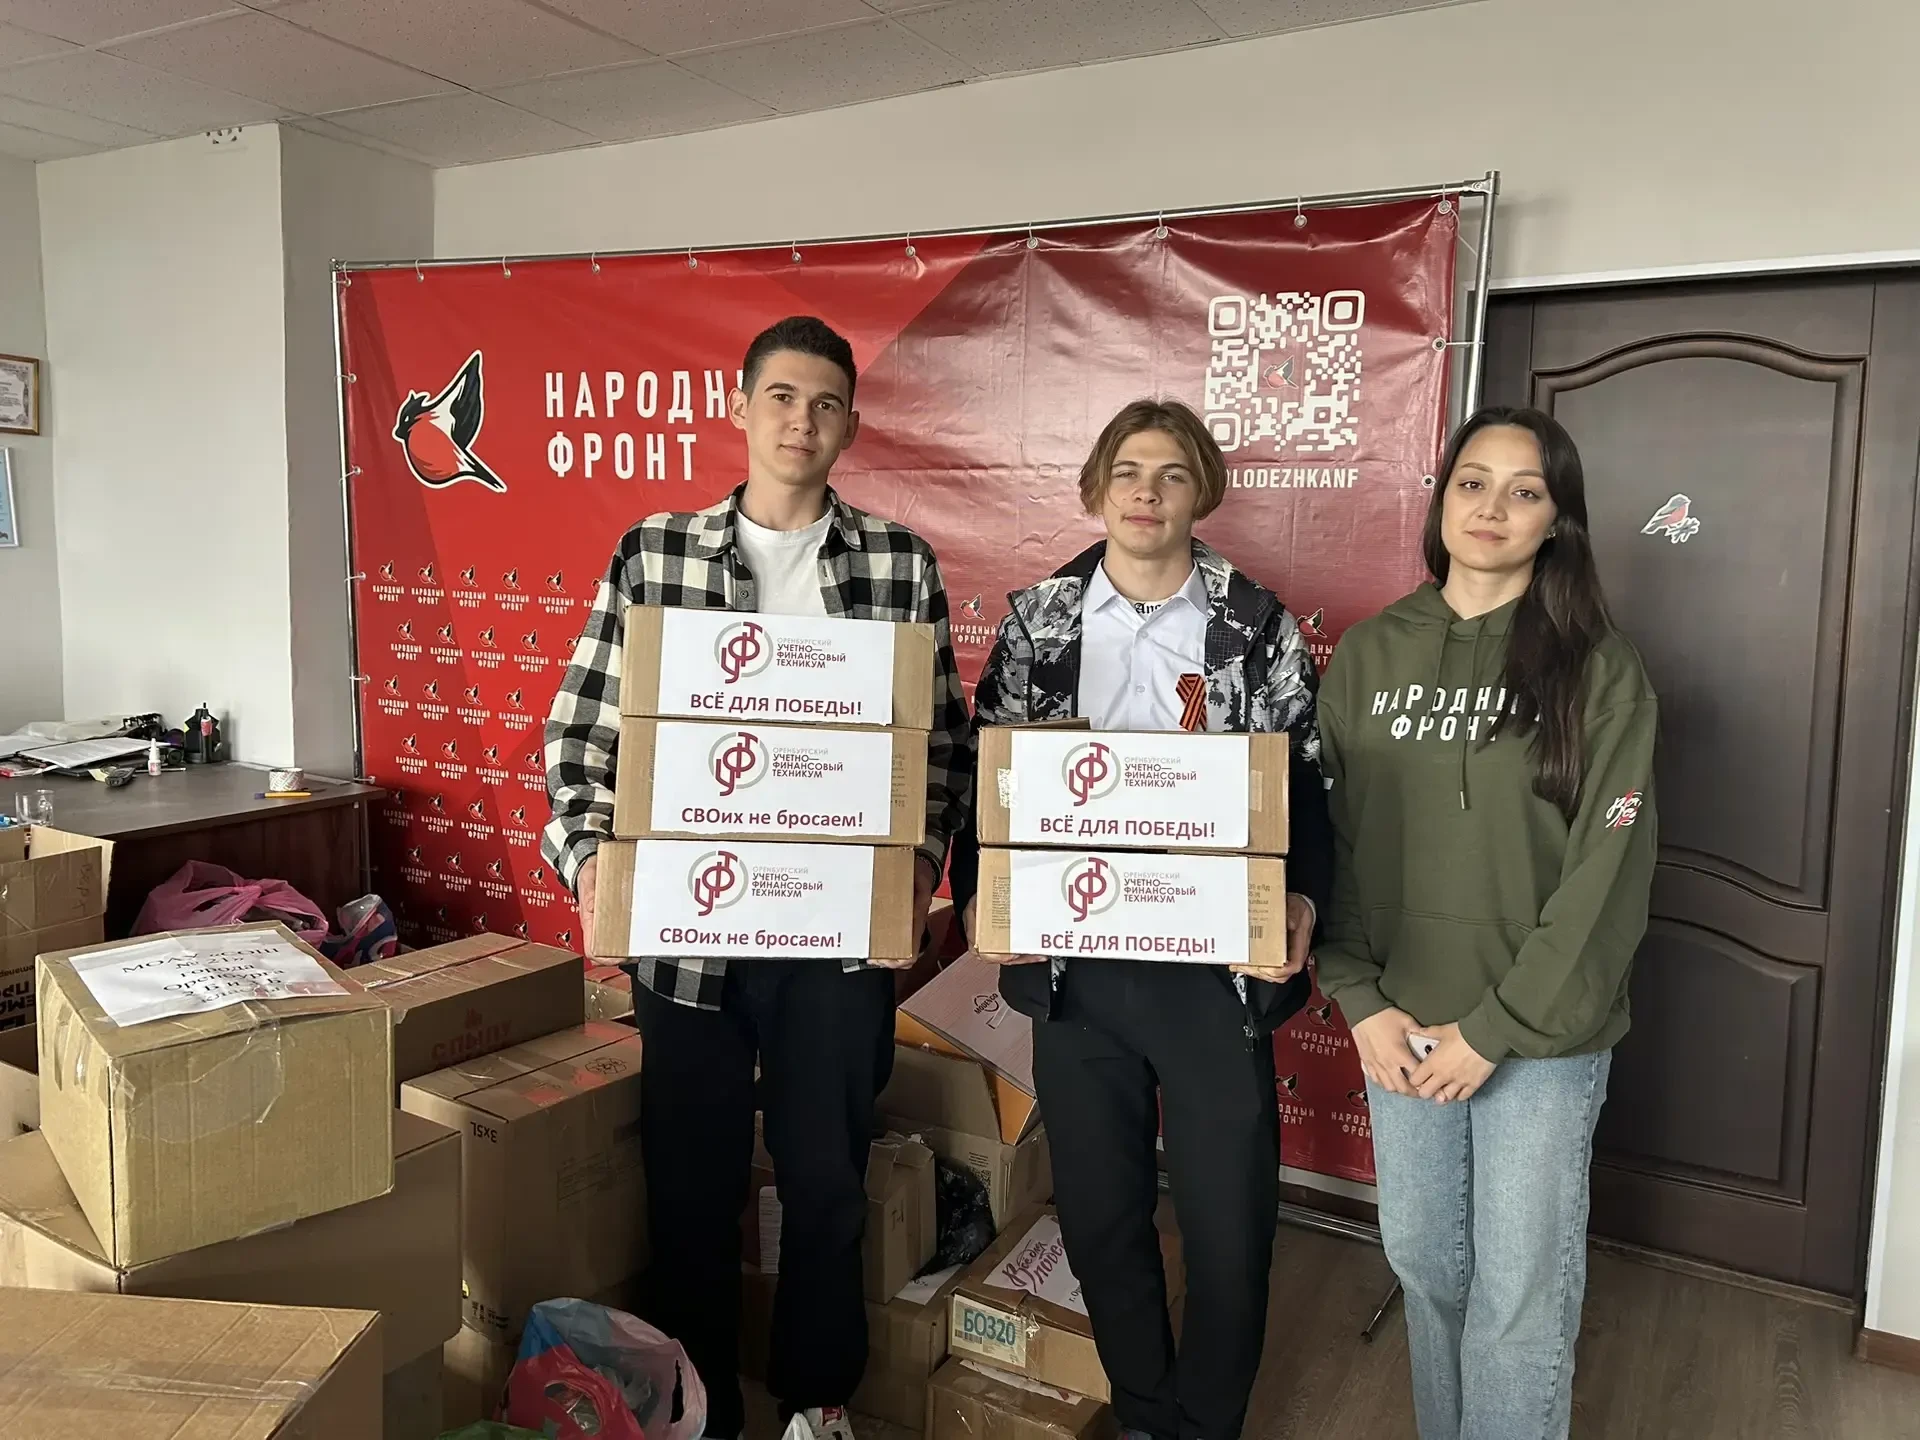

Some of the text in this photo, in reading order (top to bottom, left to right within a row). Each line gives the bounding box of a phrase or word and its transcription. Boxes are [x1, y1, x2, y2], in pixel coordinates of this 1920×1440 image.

[545, 369, 744, 424] НАРОДН
[548, 431, 696, 481] ФРОНТ
[1227, 468, 1358, 488] LODEZHKANF
[958, 635, 986, 644] ФРОНТ
[776, 652, 846, 662] ФИНАНСОВЫЙ
[776, 658, 826, 668] ТЕХНИКУМ
[690, 692, 862, 716] ВСЁ ДЛЯ ПОБЕДЫ!
[772, 761, 843, 772] ФИНАНСОВЫЙ
[517, 773, 546, 784] НАРОДН
[772, 769, 823, 778] ТЕХНИКУМ
[1124, 771, 1196, 780] ФИНАНСОВЫЙ
[1124, 779, 1176, 788] ТЕХНИКУМ
[681, 807, 863, 829] СВОих не бросаем!
[1040, 816, 1215, 839] ВСЁ ДЛЯ ПОБЕДЫ!
[752, 880, 823, 891] ФИНАНСОВЫЙ
[1124, 886, 1196, 896] ФИНАНСОВЫЙ
[752, 888, 802, 898] ТЕХНИКУМ
[1124, 894, 1175, 903] ТЕХНИКУМ
[660, 927, 841, 949] СВОих не бросаем!
[1041, 931, 1215, 955] ВСЁ ДЛЯ ПОБЕДЫ!
[164, 970, 284, 990] Оренбурга
[1291, 1029, 1349, 1048] НАРОДНЫЙ
[1301, 1042, 1338, 1056] ФРОНТ
[1279, 1104, 1315, 1117] ОДНЫЙ
[1280, 1115, 1303, 1125] ОНТ
[1332, 1112, 1372, 1126] НАРОД
[1342, 1124, 1371, 1138] ФРОН
